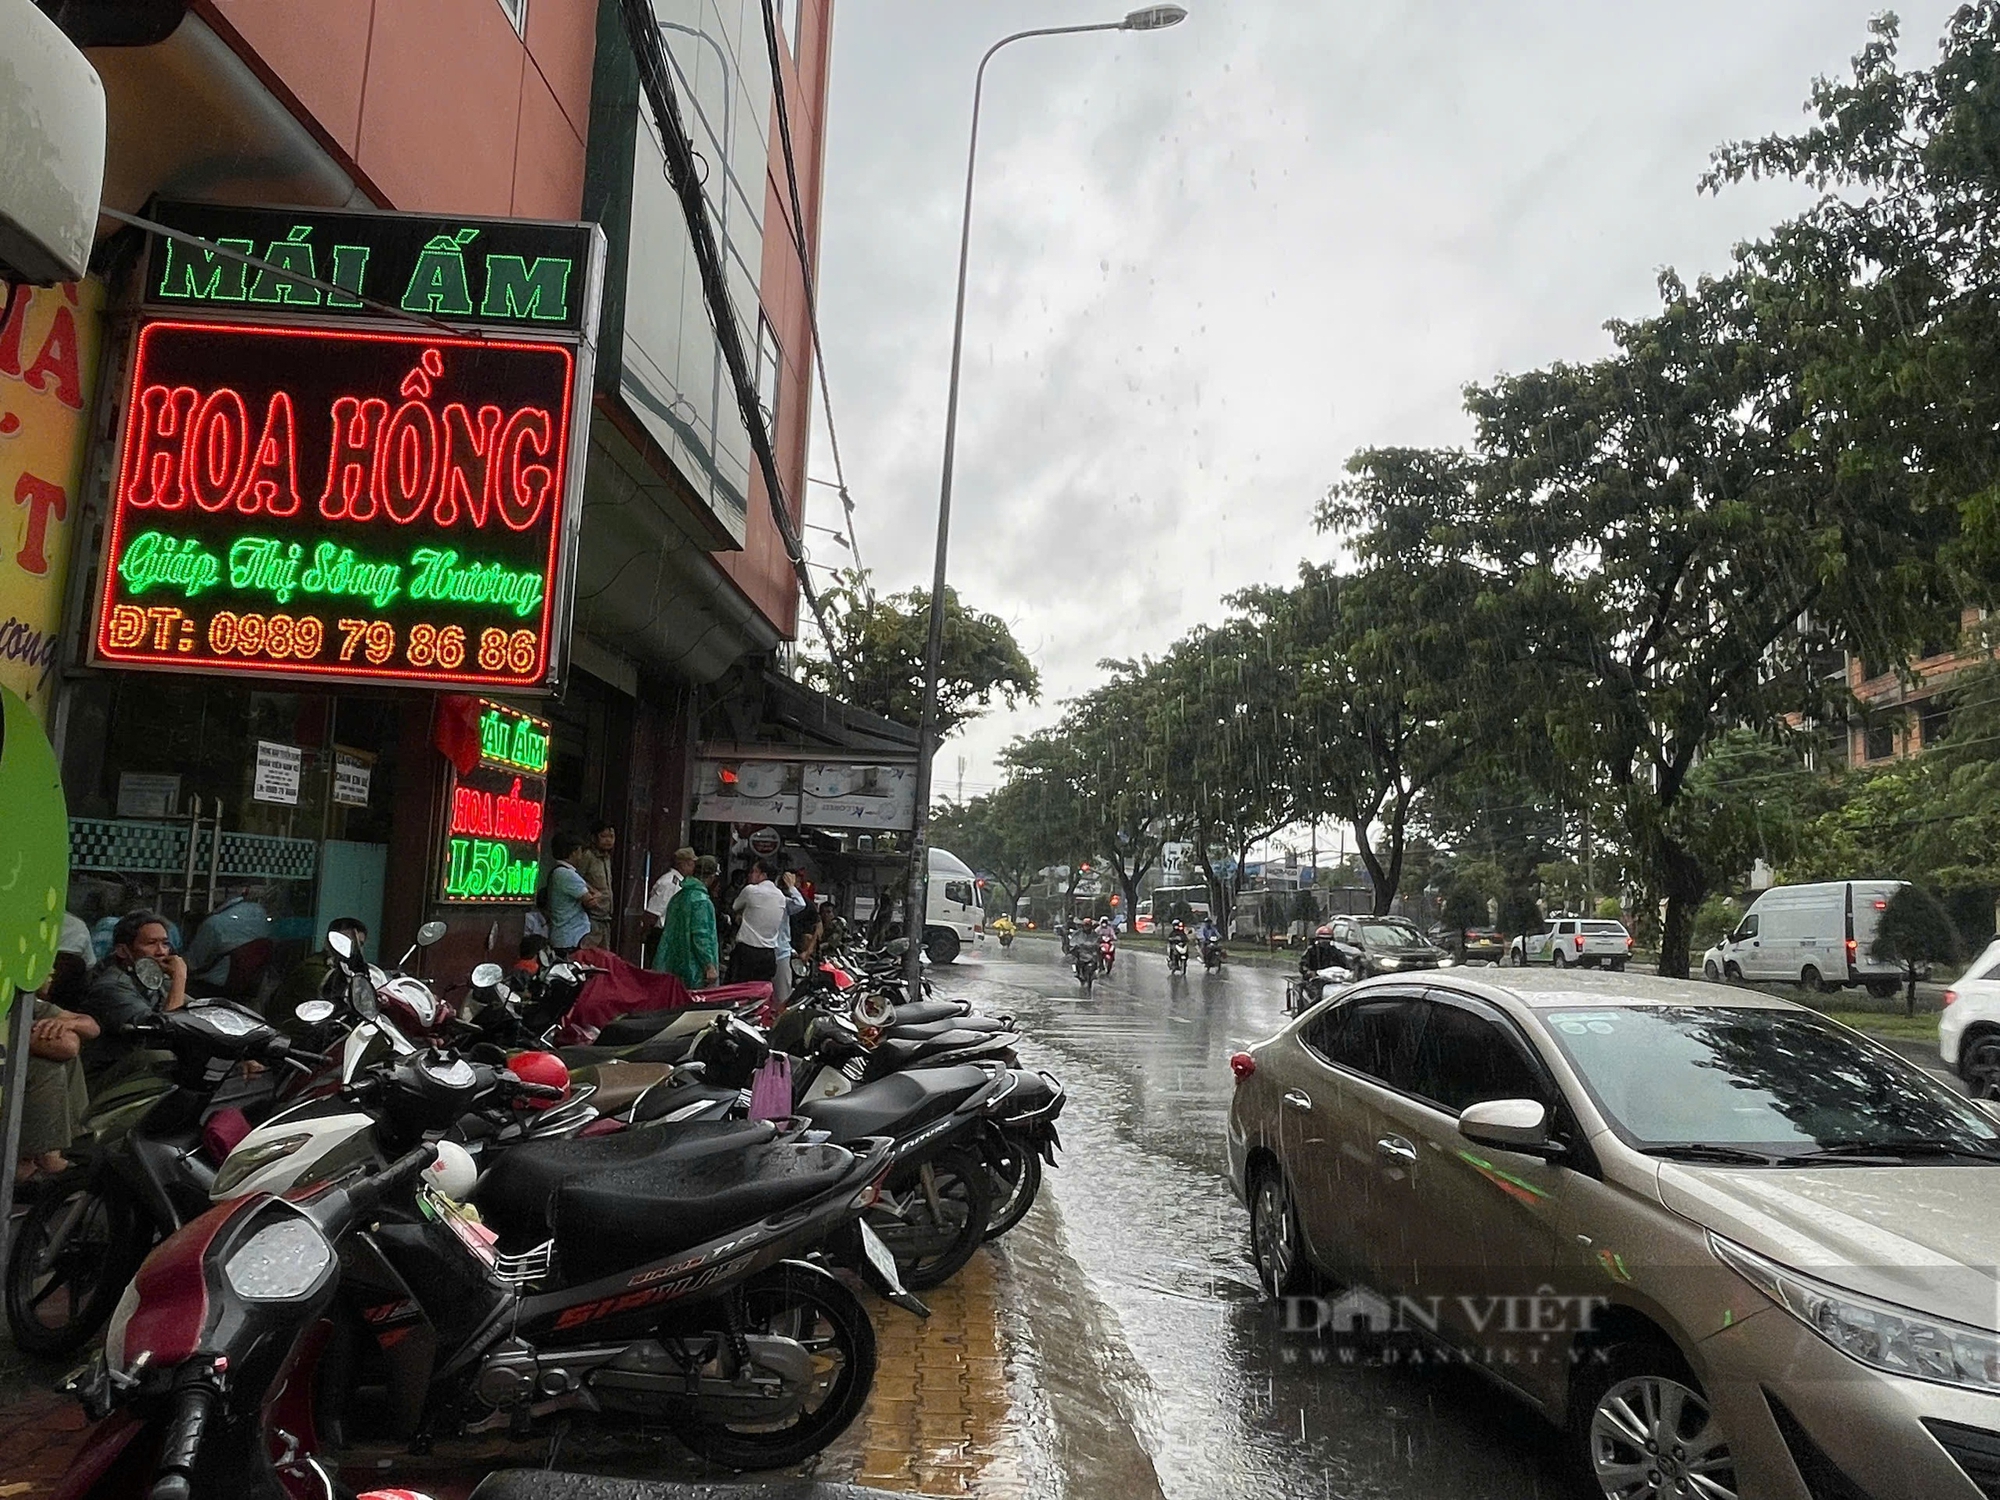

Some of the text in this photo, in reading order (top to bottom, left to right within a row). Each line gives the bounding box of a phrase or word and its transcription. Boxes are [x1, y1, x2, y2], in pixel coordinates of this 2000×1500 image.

[160, 226, 572, 320] MÁI ẤM
[128, 349, 552, 531] HOA HỒNG
[118, 531, 544, 616] Giáp Thị Sông Hương
[109, 604, 537, 674] ĐT: 0989 79 86 86
[481, 710, 511, 759] ÁI
[452, 787, 492, 836] HOA
